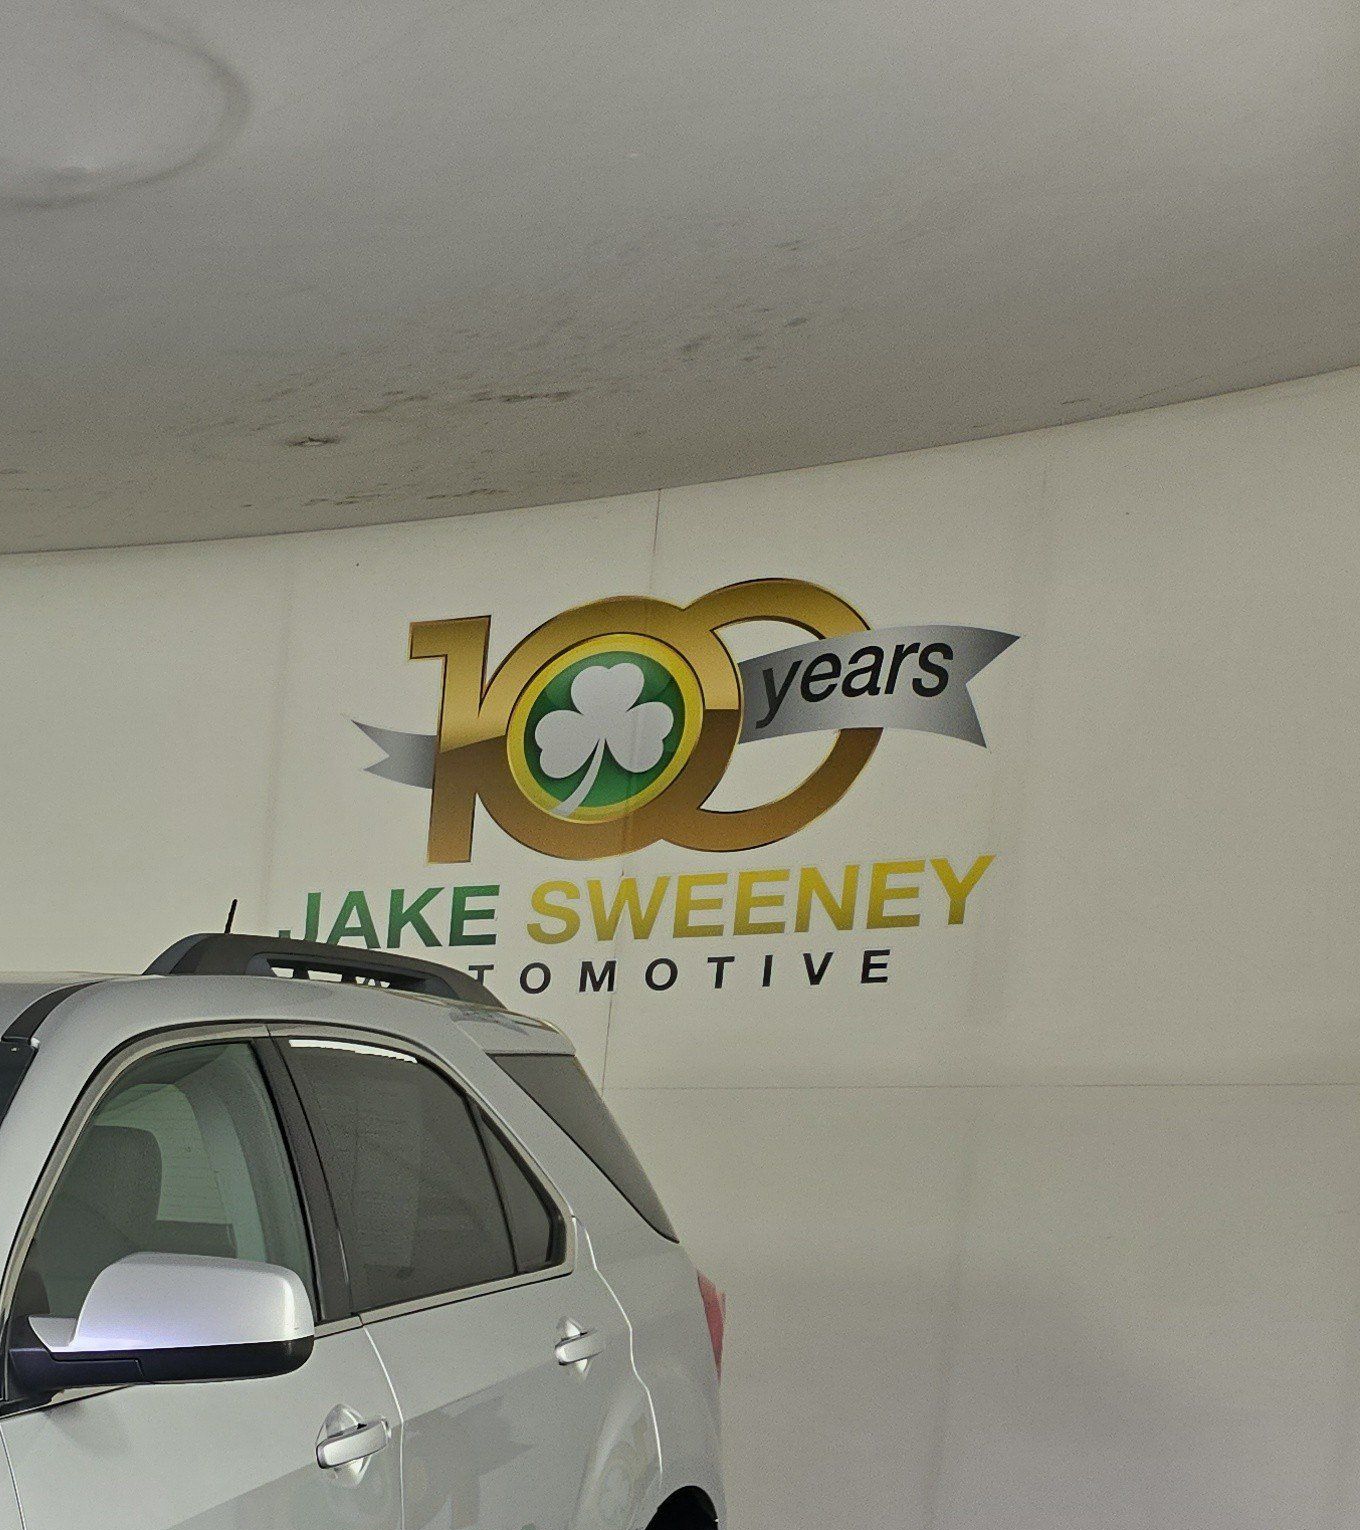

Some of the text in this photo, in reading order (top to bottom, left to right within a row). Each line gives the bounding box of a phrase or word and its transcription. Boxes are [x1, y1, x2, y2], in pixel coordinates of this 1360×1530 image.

[756, 641, 955, 729] years
[278, 854, 997, 950] JAKE SWEENEY
[468, 948, 892, 995] TOMOTIVE
